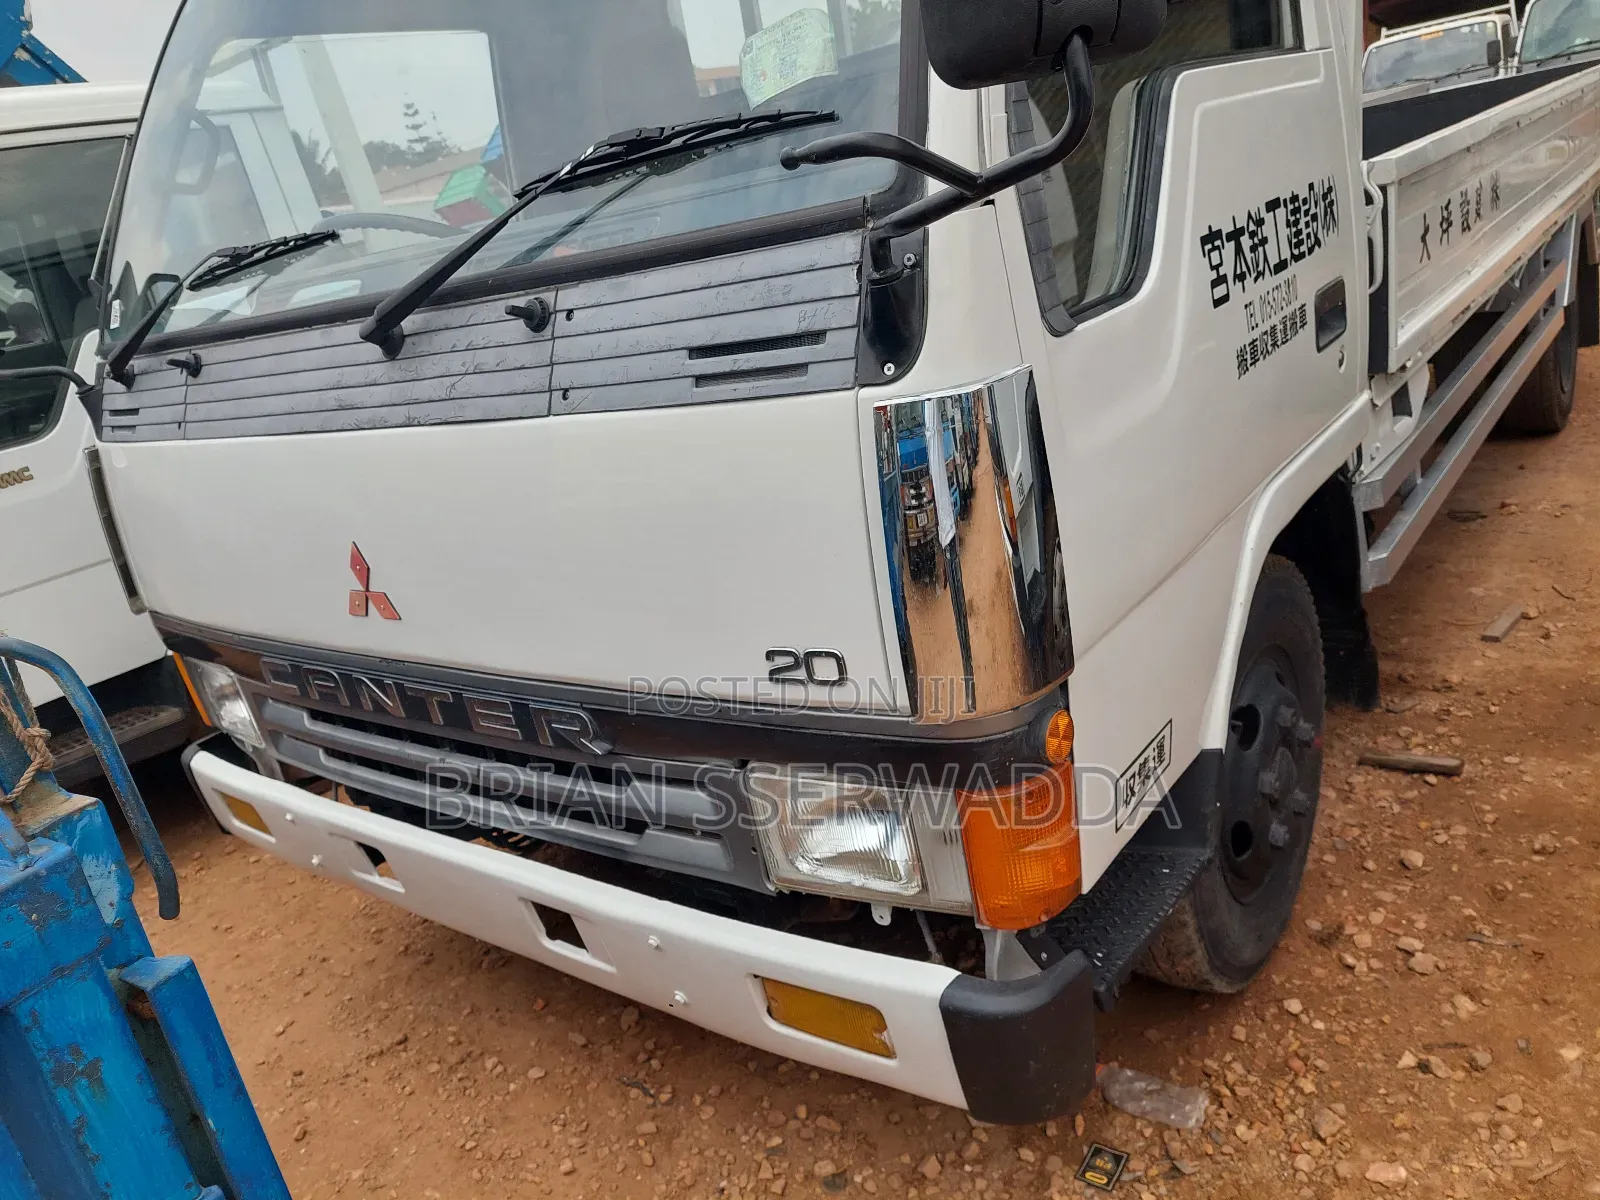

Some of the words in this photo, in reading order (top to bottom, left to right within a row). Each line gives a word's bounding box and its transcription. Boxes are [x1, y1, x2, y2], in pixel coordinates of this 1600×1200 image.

[1244, 300, 1259, 333] TEL
[765, 647, 848, 686] 20
[260, 656, 613, 756] CANTER
